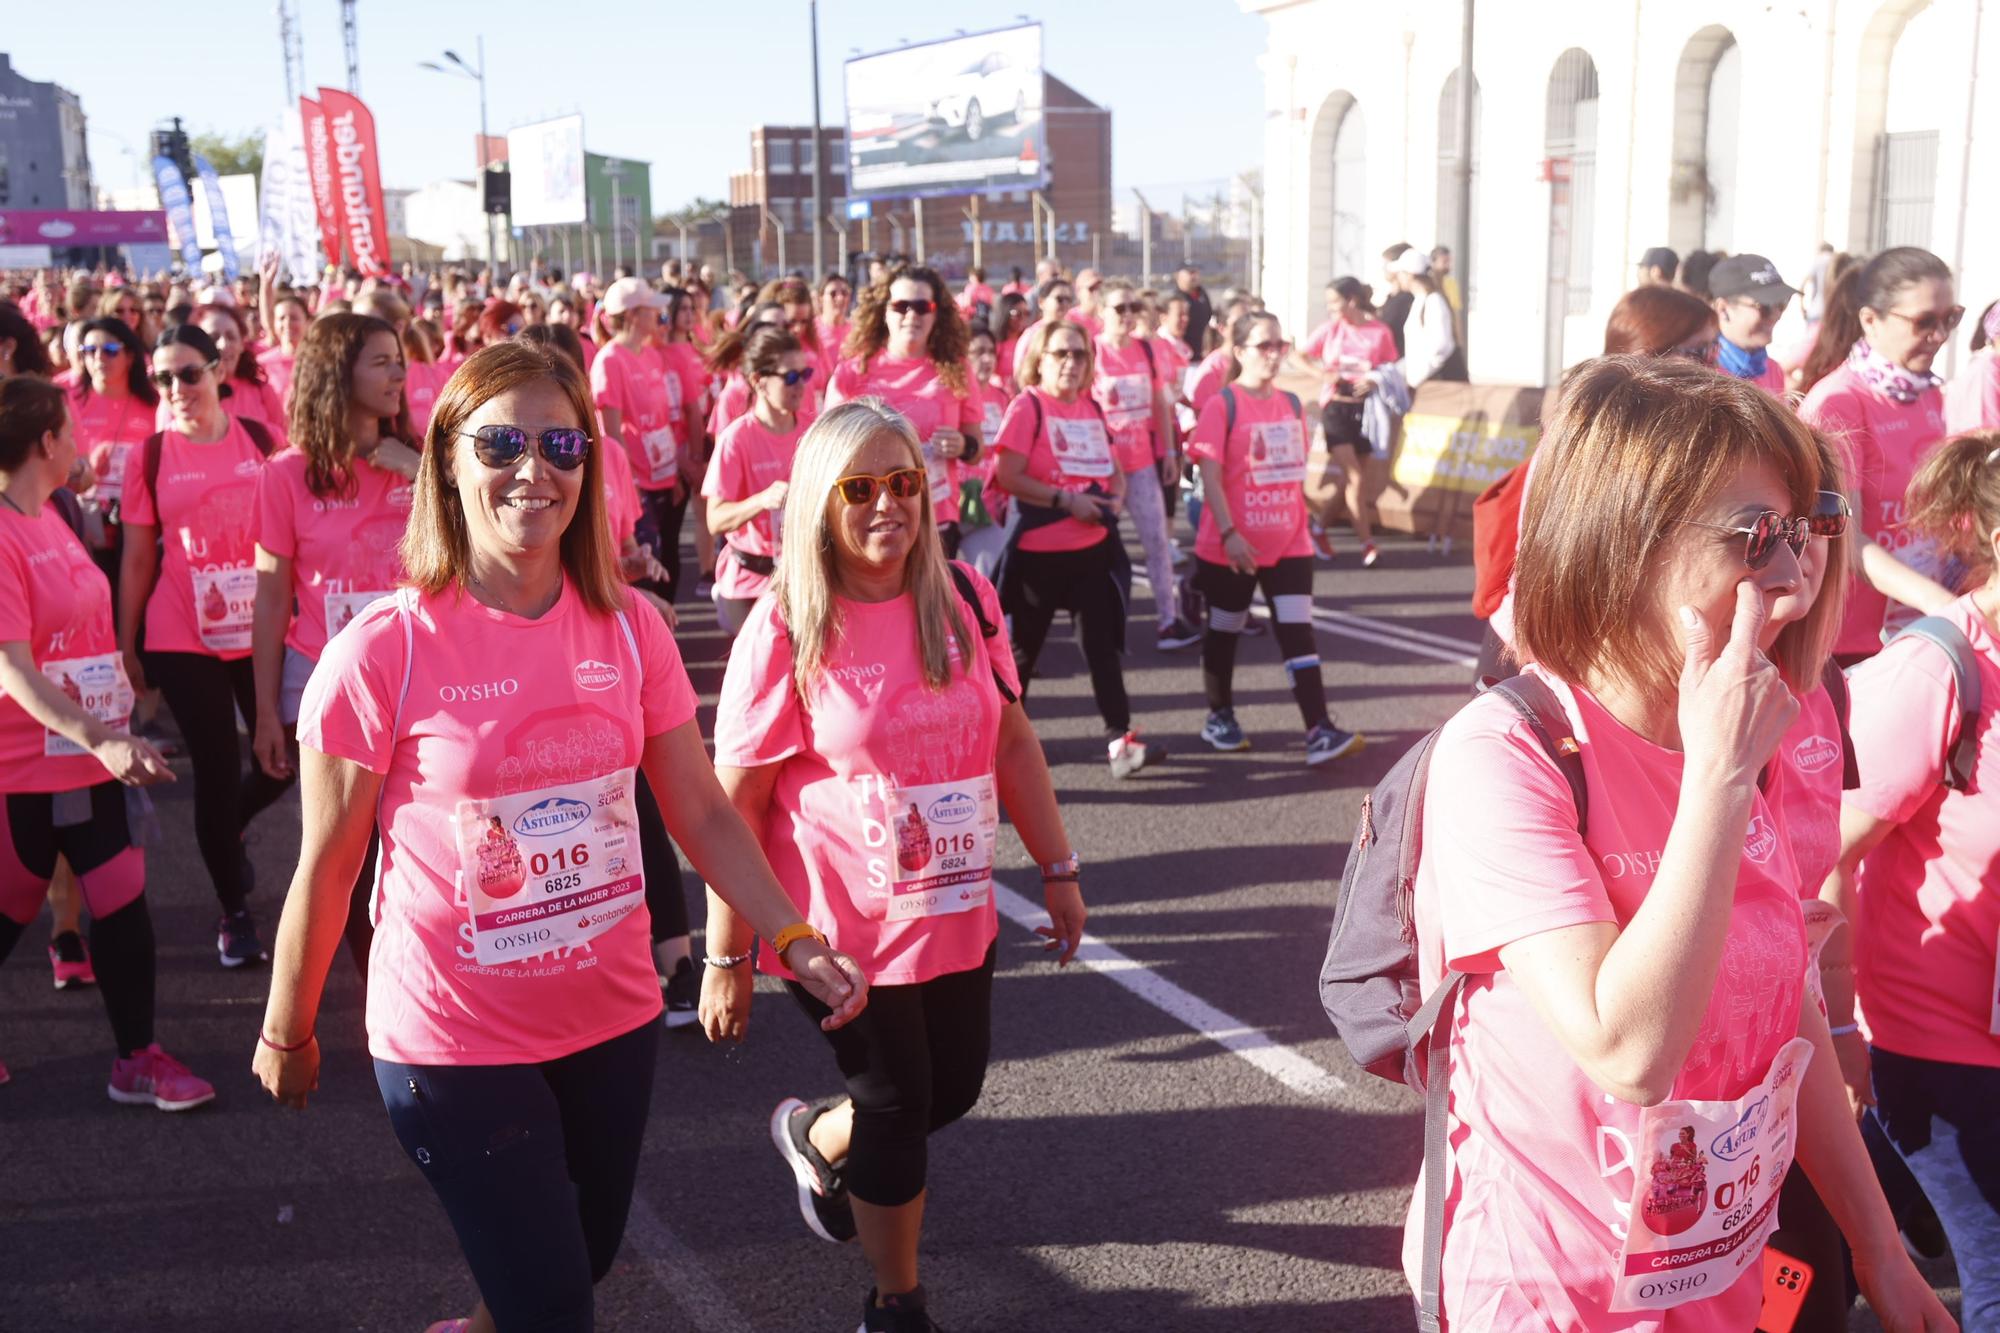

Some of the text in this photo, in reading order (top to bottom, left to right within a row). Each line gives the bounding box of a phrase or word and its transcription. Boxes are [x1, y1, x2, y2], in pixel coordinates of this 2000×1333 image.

[439, 678, 518, 702] OYSHO
[597, 791, 625, 807] SUMA
[520, 810, 585, 832] ASTURIANA
[935, 832, 974, 855] 016
[530, 843, 589, 876] 016
[941, 857, 966, 871] 6824
[1602, 850, 1662, 879] OYSH
[544, 873, 581, 894] 6825
[495, 881, 631, 925] CARRERA DE LA MUJER 2023
[591, 903, 634, 926] Santander
[900, 896, 937, 911] OYSHO
[494, 928, 551, 951] OYSHO
[455, 956, 598, 978] CARRERA DE LA MUJER 2023
[1719, 1125, 1757, 1155] ASTUR
[1713, 1154, 1761, 1211] 016
[1651, 1245, 1711, 1268] CARRERA
[1713, 1240, 1732, 1254] DE
[1732, 1230, 1743, 1248] LA
[1638, 1272, 1708, 1299] OYSHO
